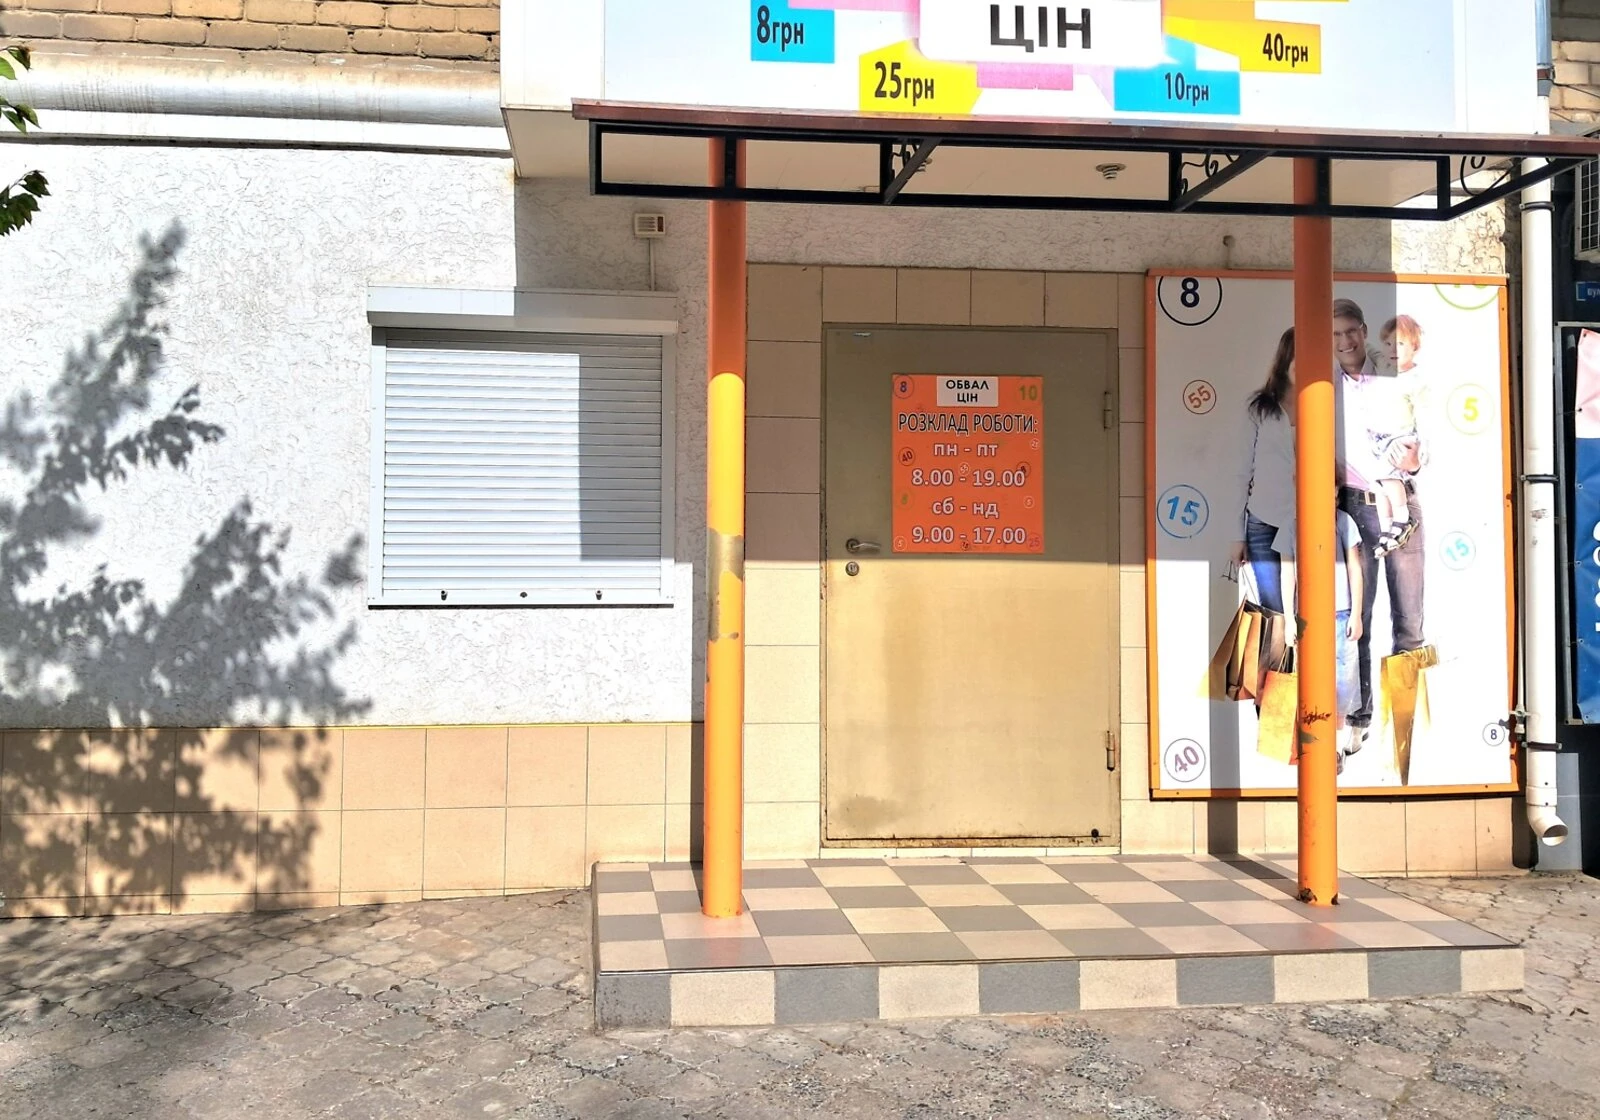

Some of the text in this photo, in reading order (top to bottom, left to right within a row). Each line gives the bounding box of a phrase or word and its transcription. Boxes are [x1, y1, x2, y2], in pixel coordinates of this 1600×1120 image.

[756, 5, 804, 52] 8грн
[990, 4, 1091, 53] ЦІН
[1262, 33, 1308, 67] 40грн
[874, 61, 935, 107] 25грн
[1164, 72, 1209, 102] 10грн
[1179, 277, 1200, 308] 8
[900, 381, 907, 392] 8
[945, 379, 990, 390] ОБВАЛ
[1019, 385, 1038, 400] 10
[957, 392, 979, 403] ЦІН
[1188, 386, 1212, 408] 55
[1463, 397, 1479, 422] 5
[898, 412, 1038, 436] РОЗКЛАД РОБОТИ:
[911, 468, 954, 486] 8.00
[972, 469, 1025, 487] 19.00
[973, 502, 999, 518] нд
[1167, 495, 1200, 526] 15
[911, 526, 954, 543] 9.00
[973, 527, 1026, 544] 17.00
[1446, 537, 1469, 561] 15
[1490, 729, 1497, 740] 8
[1174, 746, 1200, 772] 40
